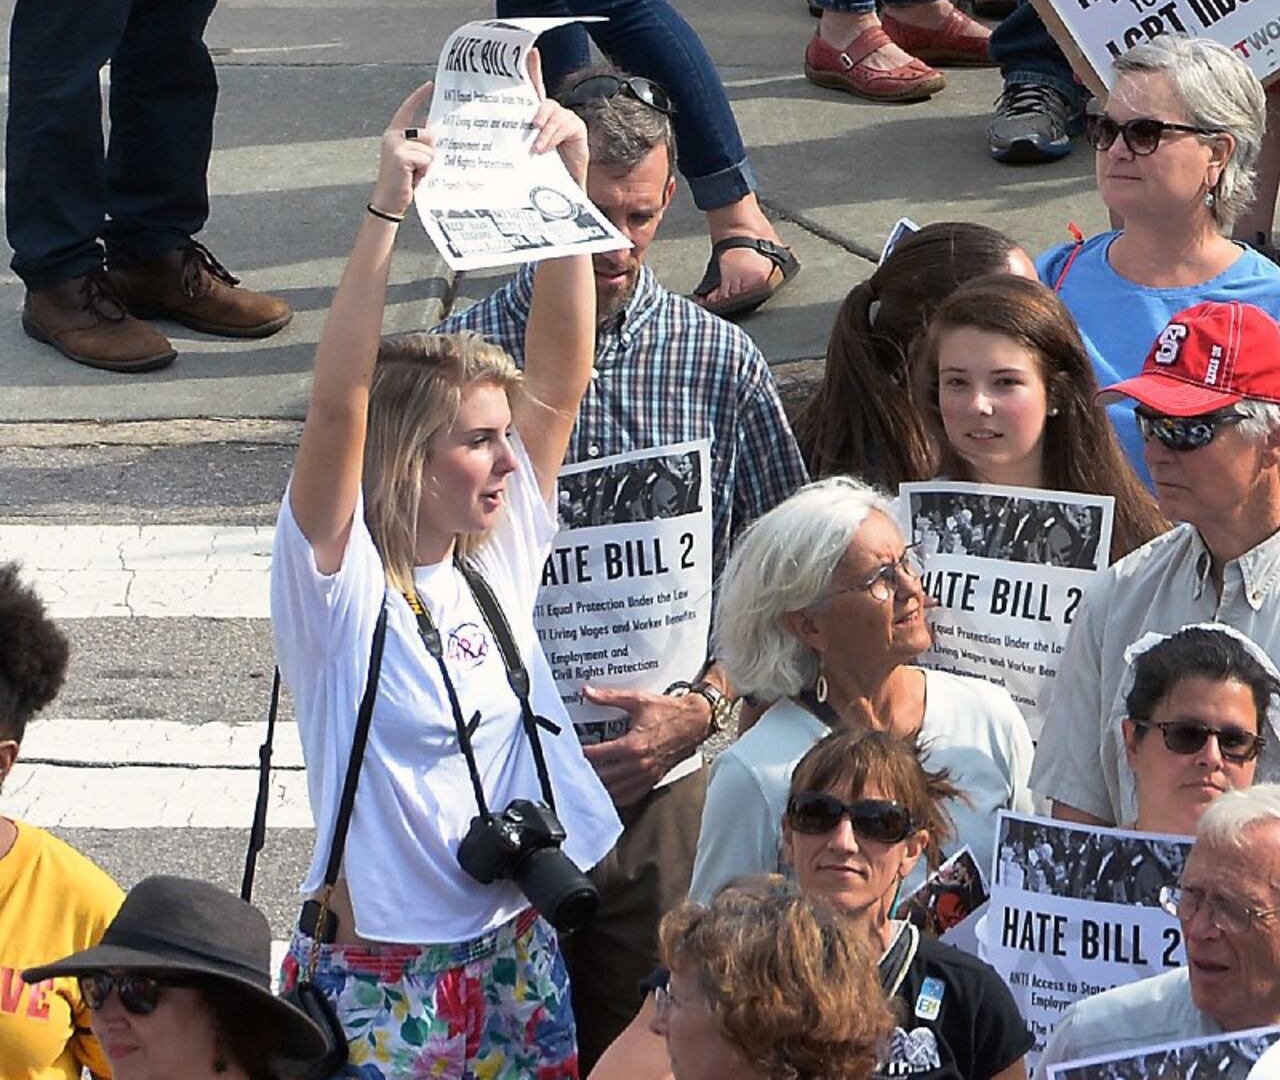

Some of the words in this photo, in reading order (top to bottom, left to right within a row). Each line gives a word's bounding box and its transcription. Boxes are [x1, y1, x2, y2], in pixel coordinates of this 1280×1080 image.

[445, 35, 481, 72] HATE
[481, 39, 513, 78] BILL
[604, 538, 669, 580] BILL
[679, 532, 695, 570] 2
[547, 602, 573, 618] Equal
[576, 597, 625, 613] Protection
[628, 594, 654, 608] Under
[657, 592, 671, 604] the
[990, 577, 1052, 622] BILL
[1063, 587, 1083, 624] 2
[549, 625, 577, 642] Living
[580, 623, 609, 640] Wages
[612, 622, 630, 635] and
[633, 618, 662, 633] Worker
[957, 626, 1001, 646] Protection
[1004, 634, 1030, 650] Under
[1034, 640, 1049, 653] the
[1051, 643, 1065, 655] La
[551, 647, 608, 665] Employment
[610, 645, 628, 658] and
[933, 643, 959, 660] Living
[960, 648, 987, 665] Wages
[989, 656, 1005, 668] and
[1007, 661, 1036, 675] Worker
[552, 668, 572, 681] Civil
[575, 666, 605, 681] Rights
[607, 659, 659, 676] Protections
[1002, 906, 1068, 957] HATE
[1081, 919, 1148, 966] BILL
[1162, 928, 1181, 967] 2
[1010, 971, 1029, 987] ANTI
[1032, 975, 1064, 992] Access
[1067, 981, 1077, 994] to
[1031, 992, 1071, 1013] Employm
